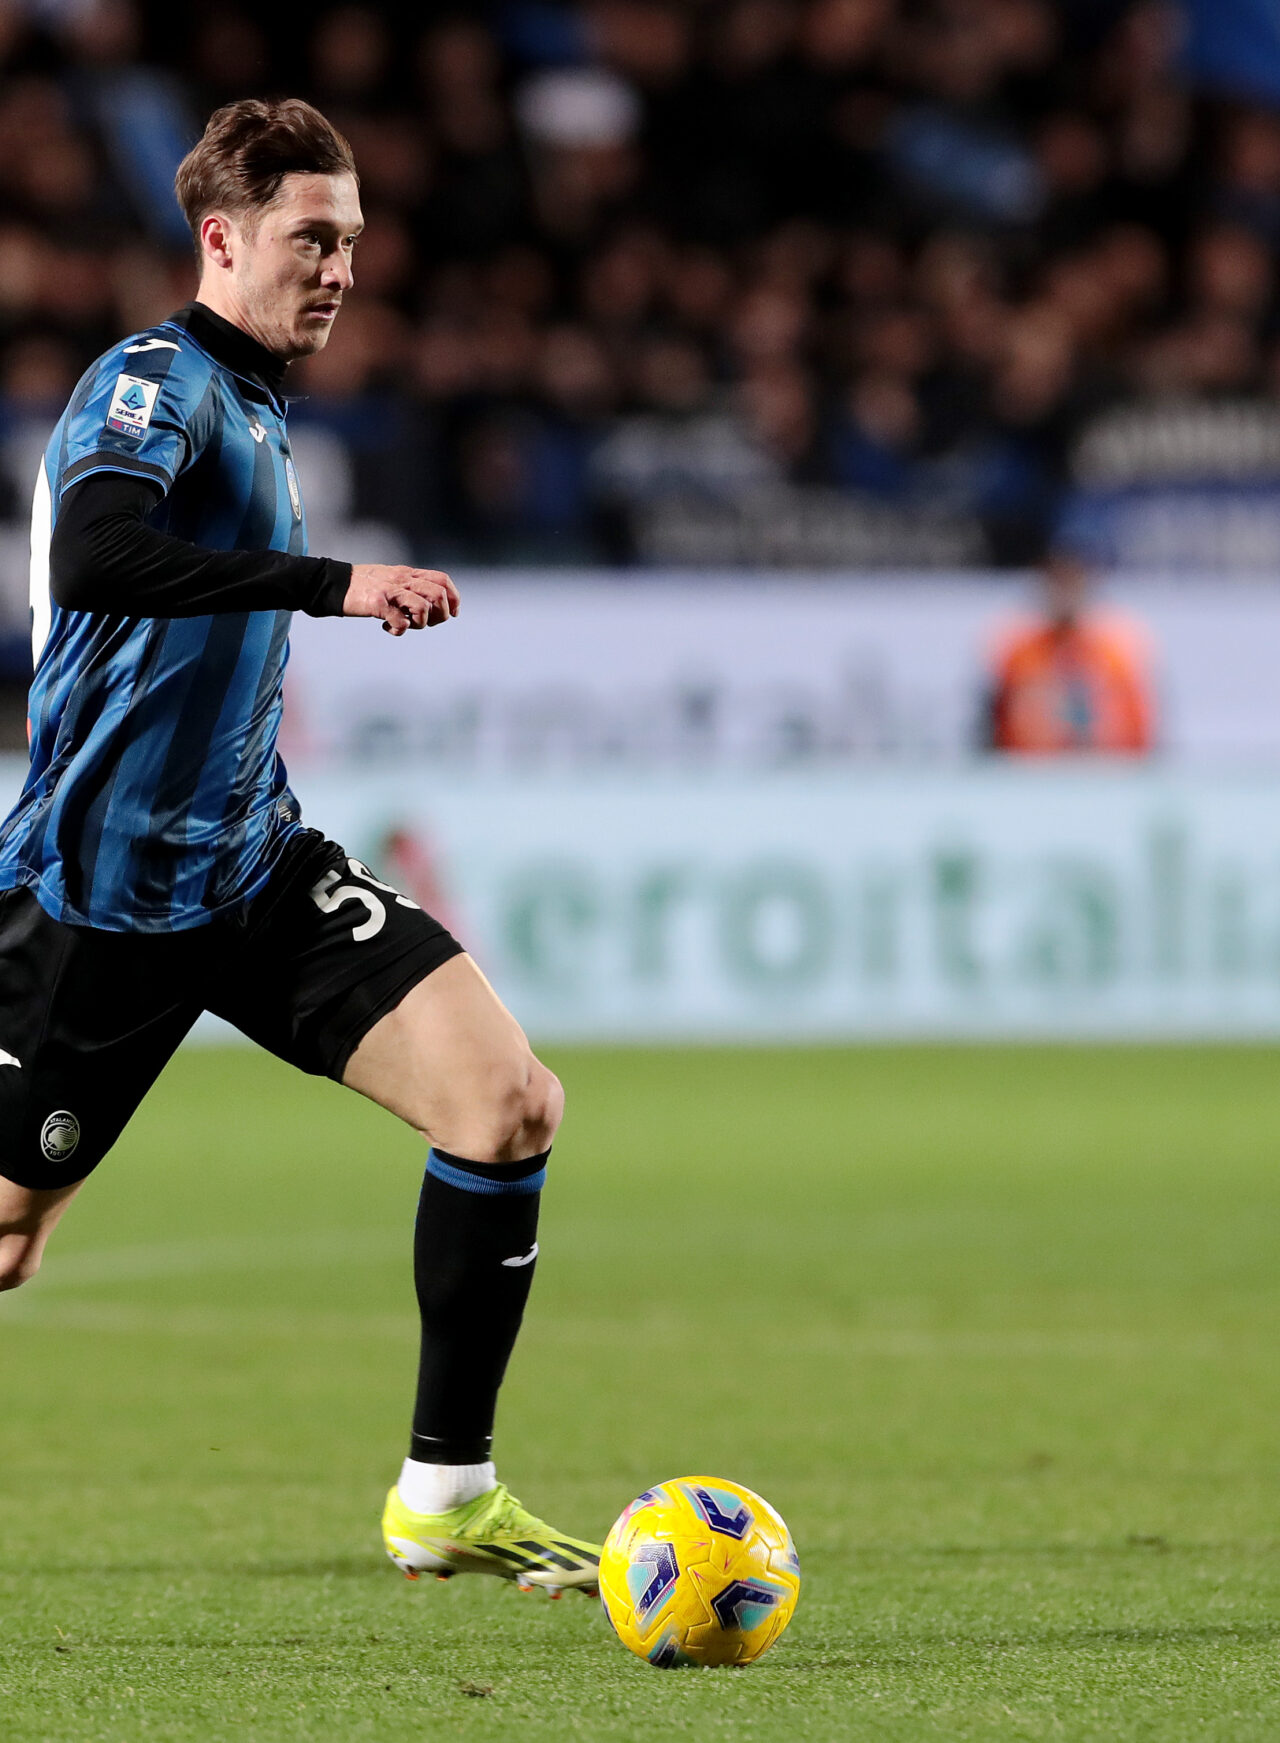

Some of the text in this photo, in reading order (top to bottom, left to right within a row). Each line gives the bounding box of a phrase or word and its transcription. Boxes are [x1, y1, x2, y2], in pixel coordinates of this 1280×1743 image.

[115, 408, 138, 420] SERIE
[122, 424, 142, 437] TIM
[309, 858, 421, 942] 59
